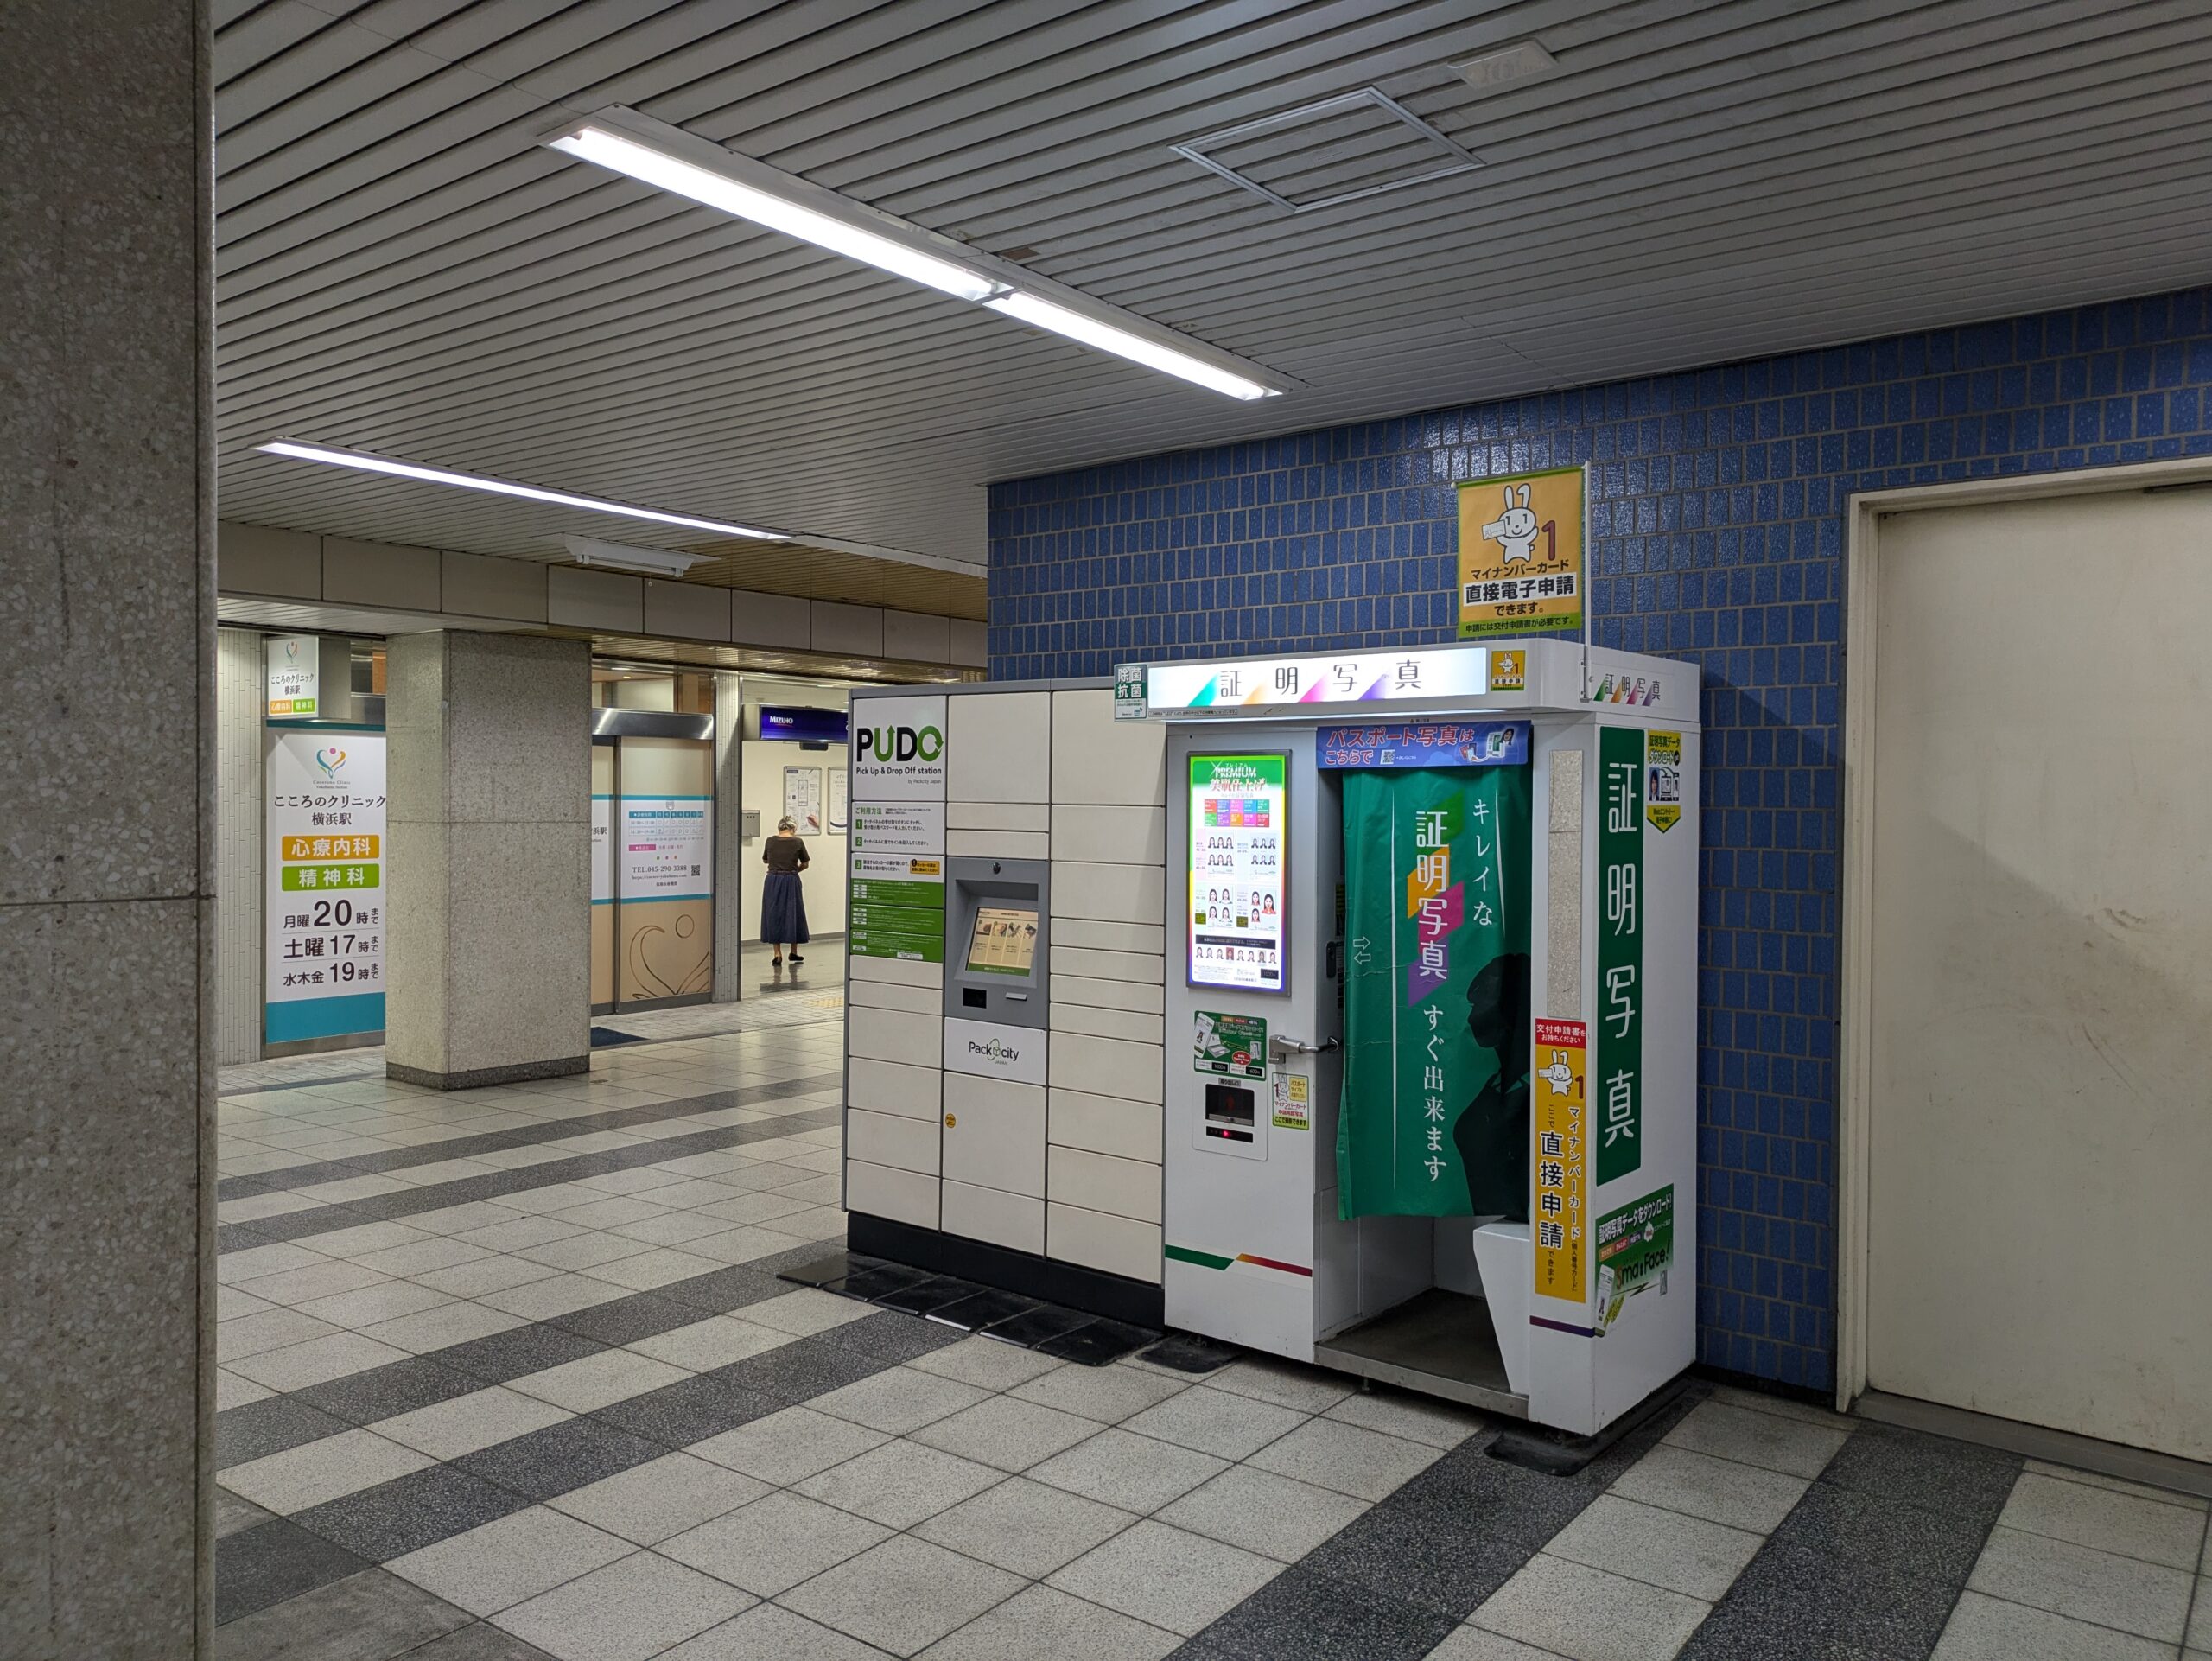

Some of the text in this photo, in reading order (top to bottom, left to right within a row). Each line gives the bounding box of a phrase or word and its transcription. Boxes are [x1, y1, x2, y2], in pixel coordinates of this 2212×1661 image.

[1471, 559, 1570, 580] マイナンバーカード
[1465, 575, 1575, 604] 直接電子申請
[1494, 602, 1544, 617] できます。
[1465, 616, 1573, 633] 申請には交付申請書が必要です。
[270, 673, 315, 684] こころのクリニック
[1117, 668, 1142, 683] 除菌
[1220, 659, 1421, 697] 証明写真
[284, 685, 301, 695] 横浜駅
[1117, 684, 1142, 698] 抗菌
[1605, 673, 1661, 701] 証明写真
[769, 716, 794, 724] MIZUHO
[856, 725, 944, 762] PUDO
[1326, 725, 1475, 747] パスポート写真は
[1325, 750, 1374, 765] こちらで
[856, 767, 869, 775] Pick
[870, 767, 880, 776] Up
[887, 767, 903, 776] Drop
[904, 767, 917, 775] Off
[918, 766, 942, 775] station
[1215, 767, 1256, 778] PREMIUM
[274, 795, 386, 808] こころのクリニック
[312, 812, 353, 826] 横浜駅
[591, 826, 607, 835] 浜駅
[291, 837, 371, 857] 心療内科
[1472, 799, 1493, 926] キレイな
[298, 867, 365, 888] 精神科
[1415, 811, 1449, 980] 証明写真
[1605, 762, 1637, 1148] 証明写真
[1536, 1024, 1586, 1037] 交付申請書を
[1541, 1034, 1581, 1043] お持ちください
[1423, 1004, 1447, 1182] すぐ出来ます
[1568, 1106, 1580, 1239] マイナンバーカード
[1540, 1131, 1564, 1250] 直接申請
